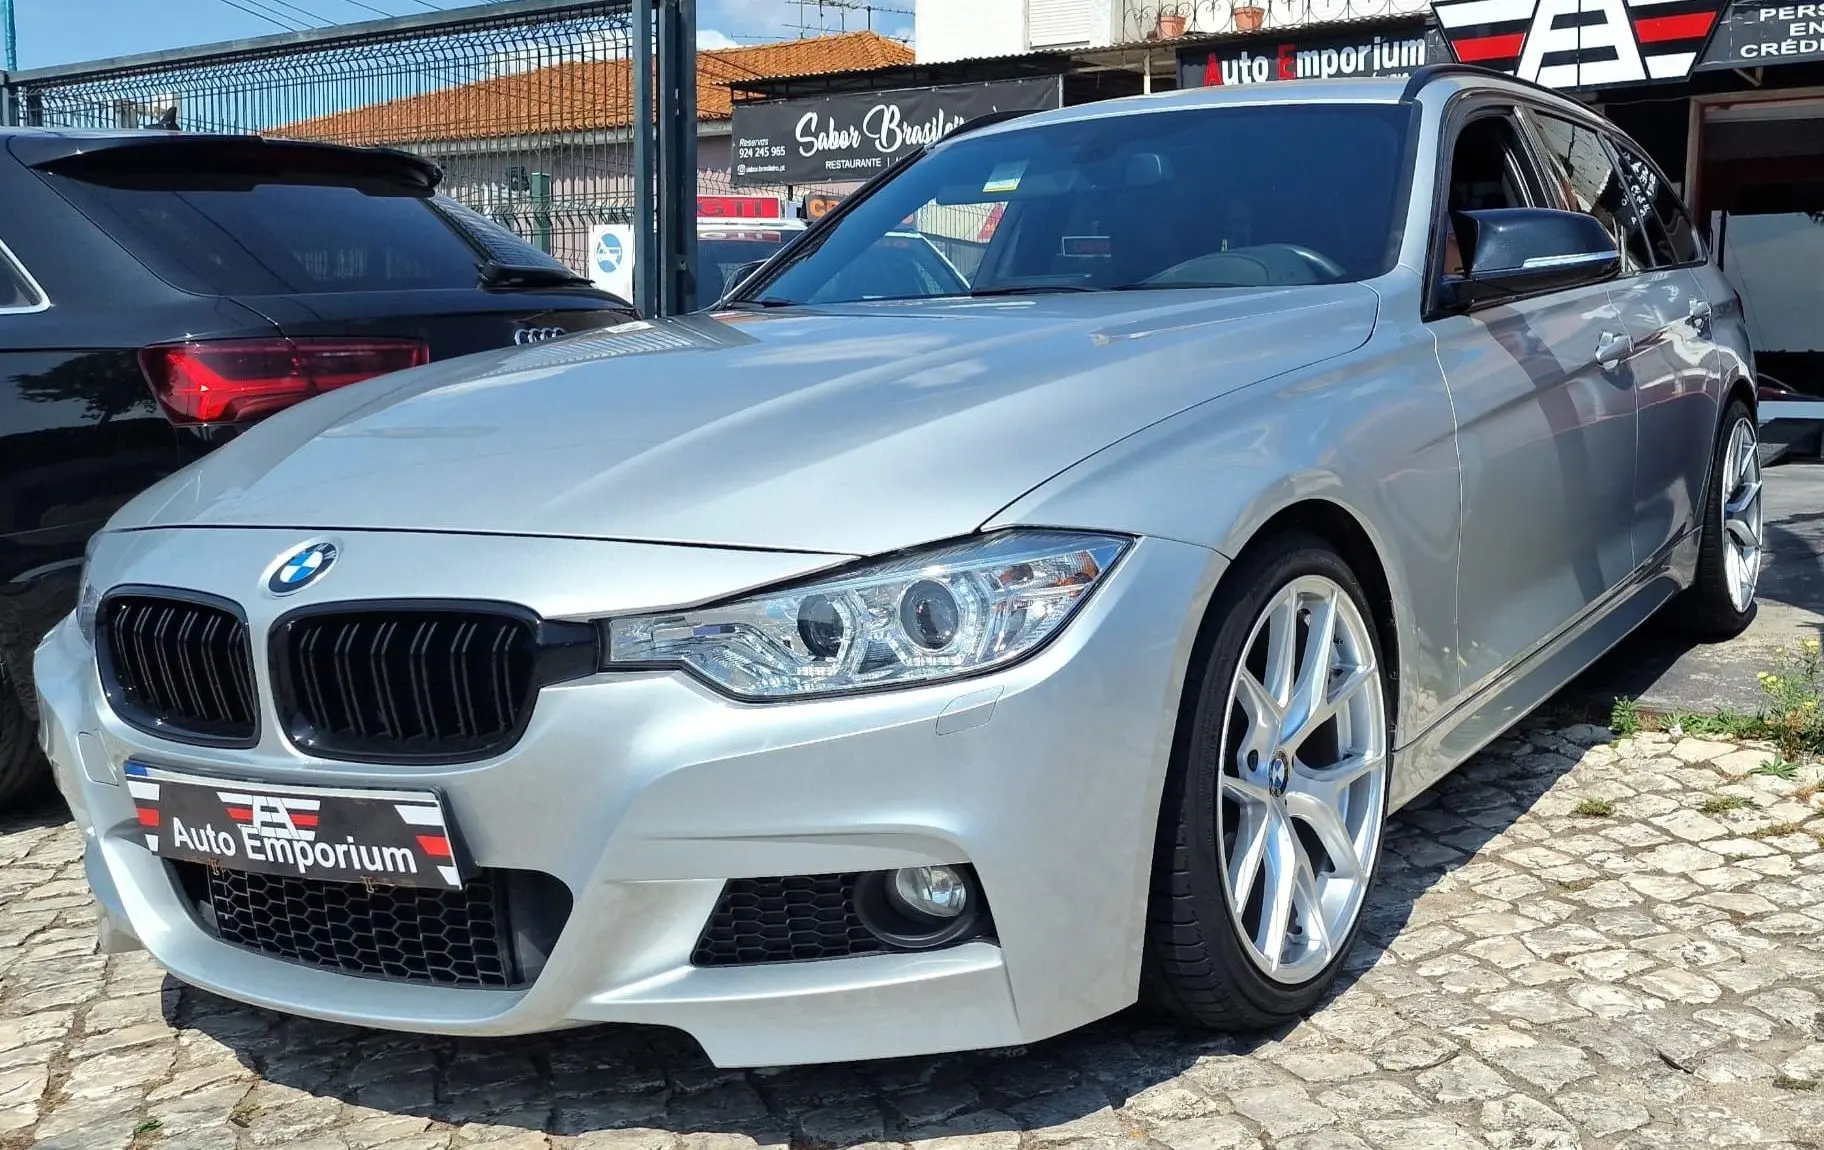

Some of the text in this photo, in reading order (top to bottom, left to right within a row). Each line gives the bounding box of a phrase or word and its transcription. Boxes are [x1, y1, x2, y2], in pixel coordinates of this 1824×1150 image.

[1204, 36, 1425, 87] Auto Emporium
[739, 138, 769, 147] Reservas
[795, 111, 861, 157] Sabor
[739, 148, 753, 158] 924
[755, 147, 770, 157] 245
[825, 157, 882, 170] RESTAURANTE
[171, 816, 418, 874] Auto Emporium
